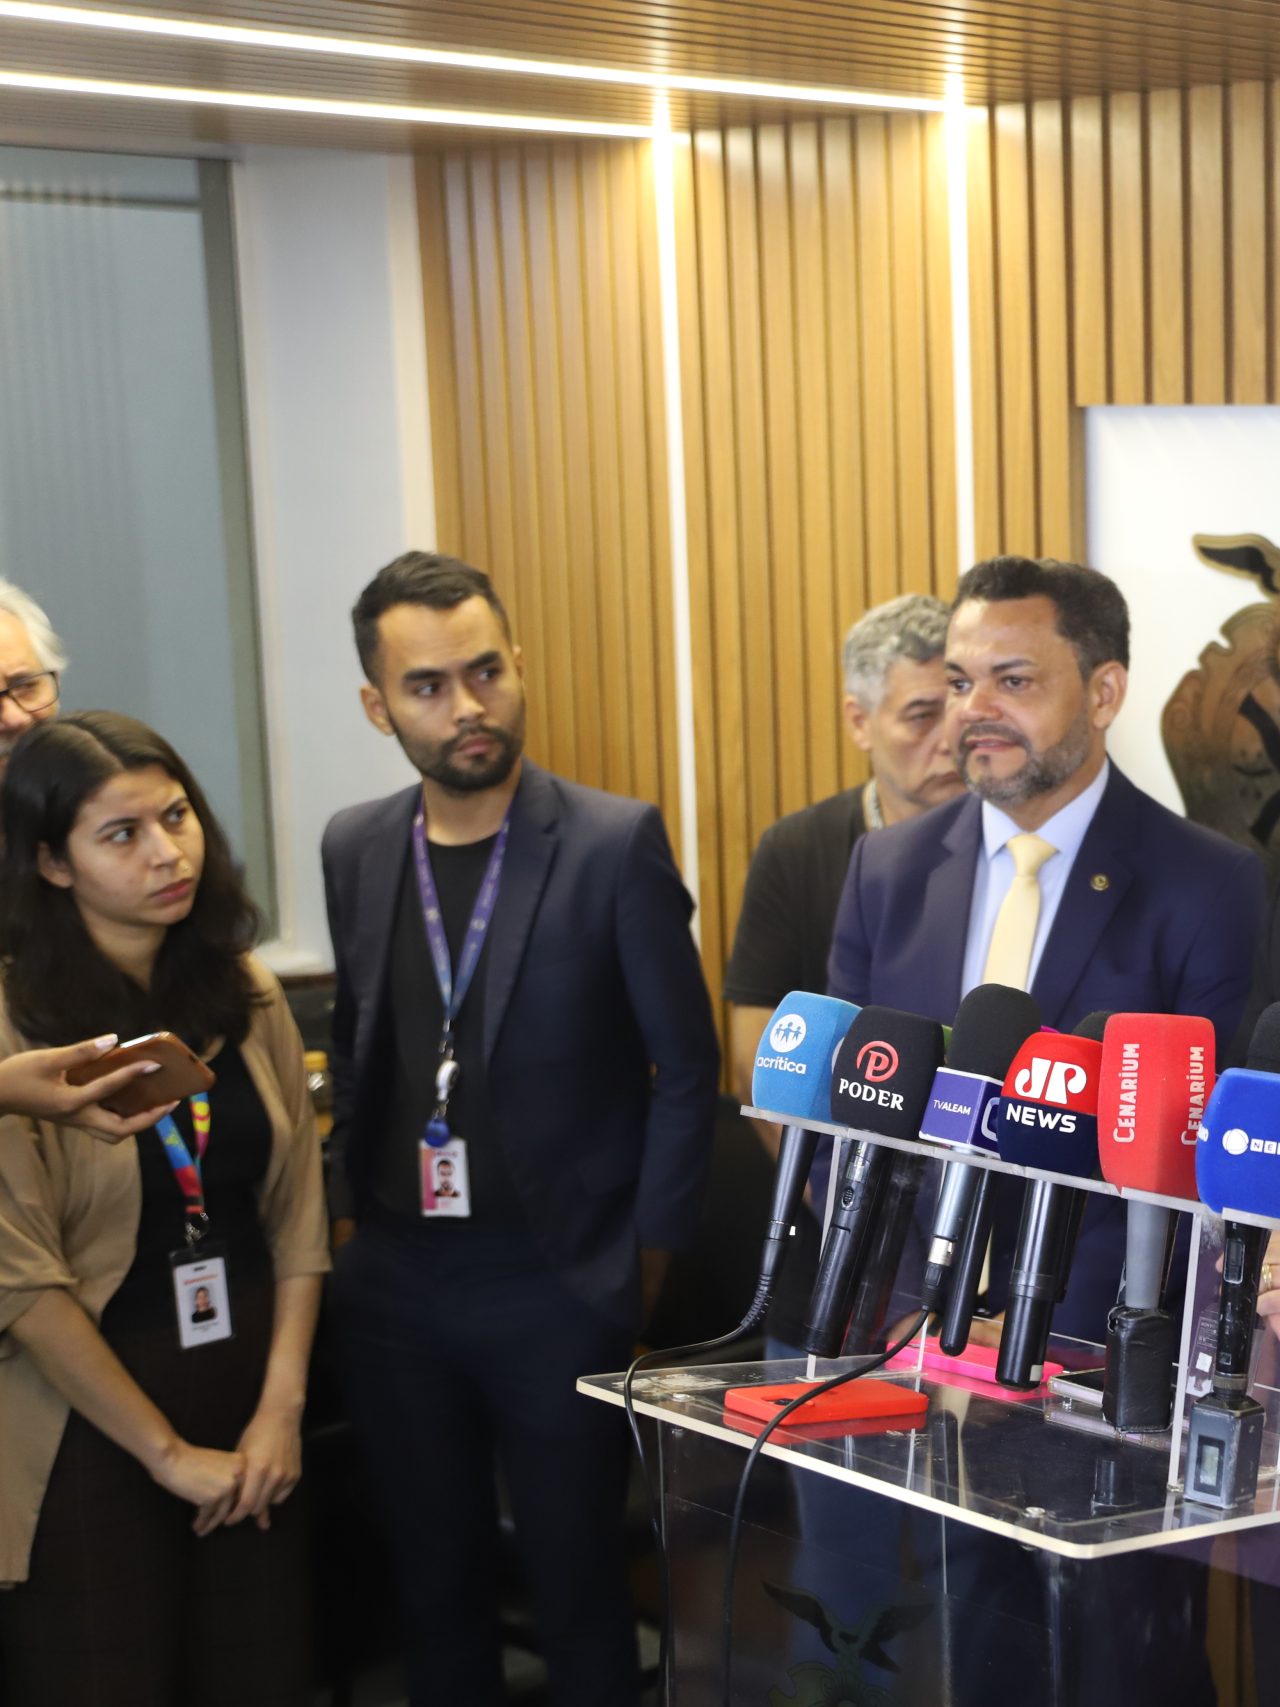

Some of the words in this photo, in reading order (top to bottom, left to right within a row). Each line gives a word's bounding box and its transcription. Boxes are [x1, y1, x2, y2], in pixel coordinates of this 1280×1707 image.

[839, 1077, 904, 1111] PODER
[933, 1099, 971, 1115] TVALEAM
[1006, 1103, 1077, 1133] NEWS
